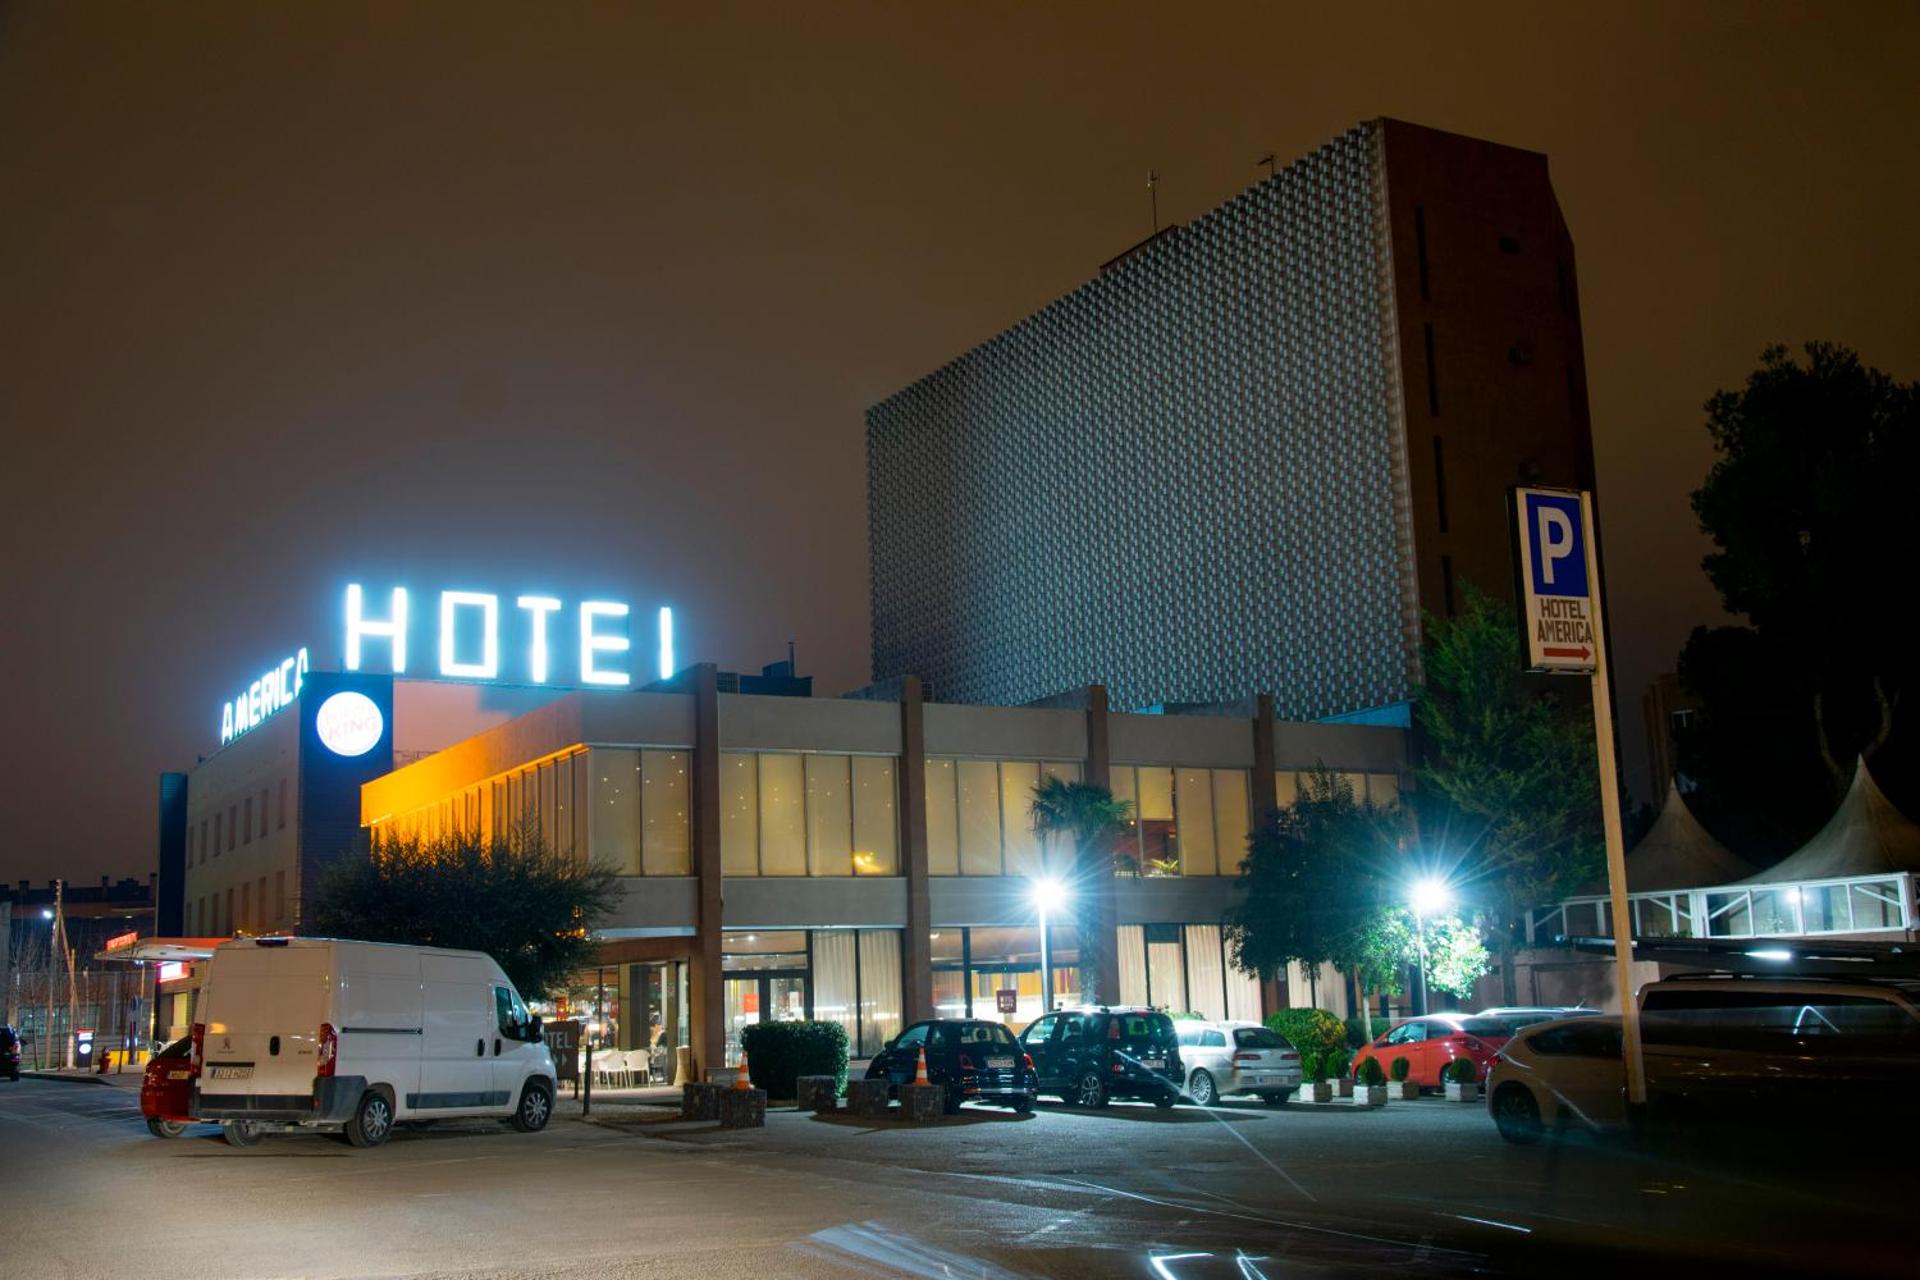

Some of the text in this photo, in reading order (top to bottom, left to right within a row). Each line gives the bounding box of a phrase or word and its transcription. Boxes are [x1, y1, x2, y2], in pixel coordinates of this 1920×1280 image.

[1537, 506, 1574, 585] P
[1540, 598, 1586, 620] HOTEL
[1537, 619, 1594, 644] AMERICA
[221, 647, 308, 746] AMERICA
[328, 714, 379, 742] KING
